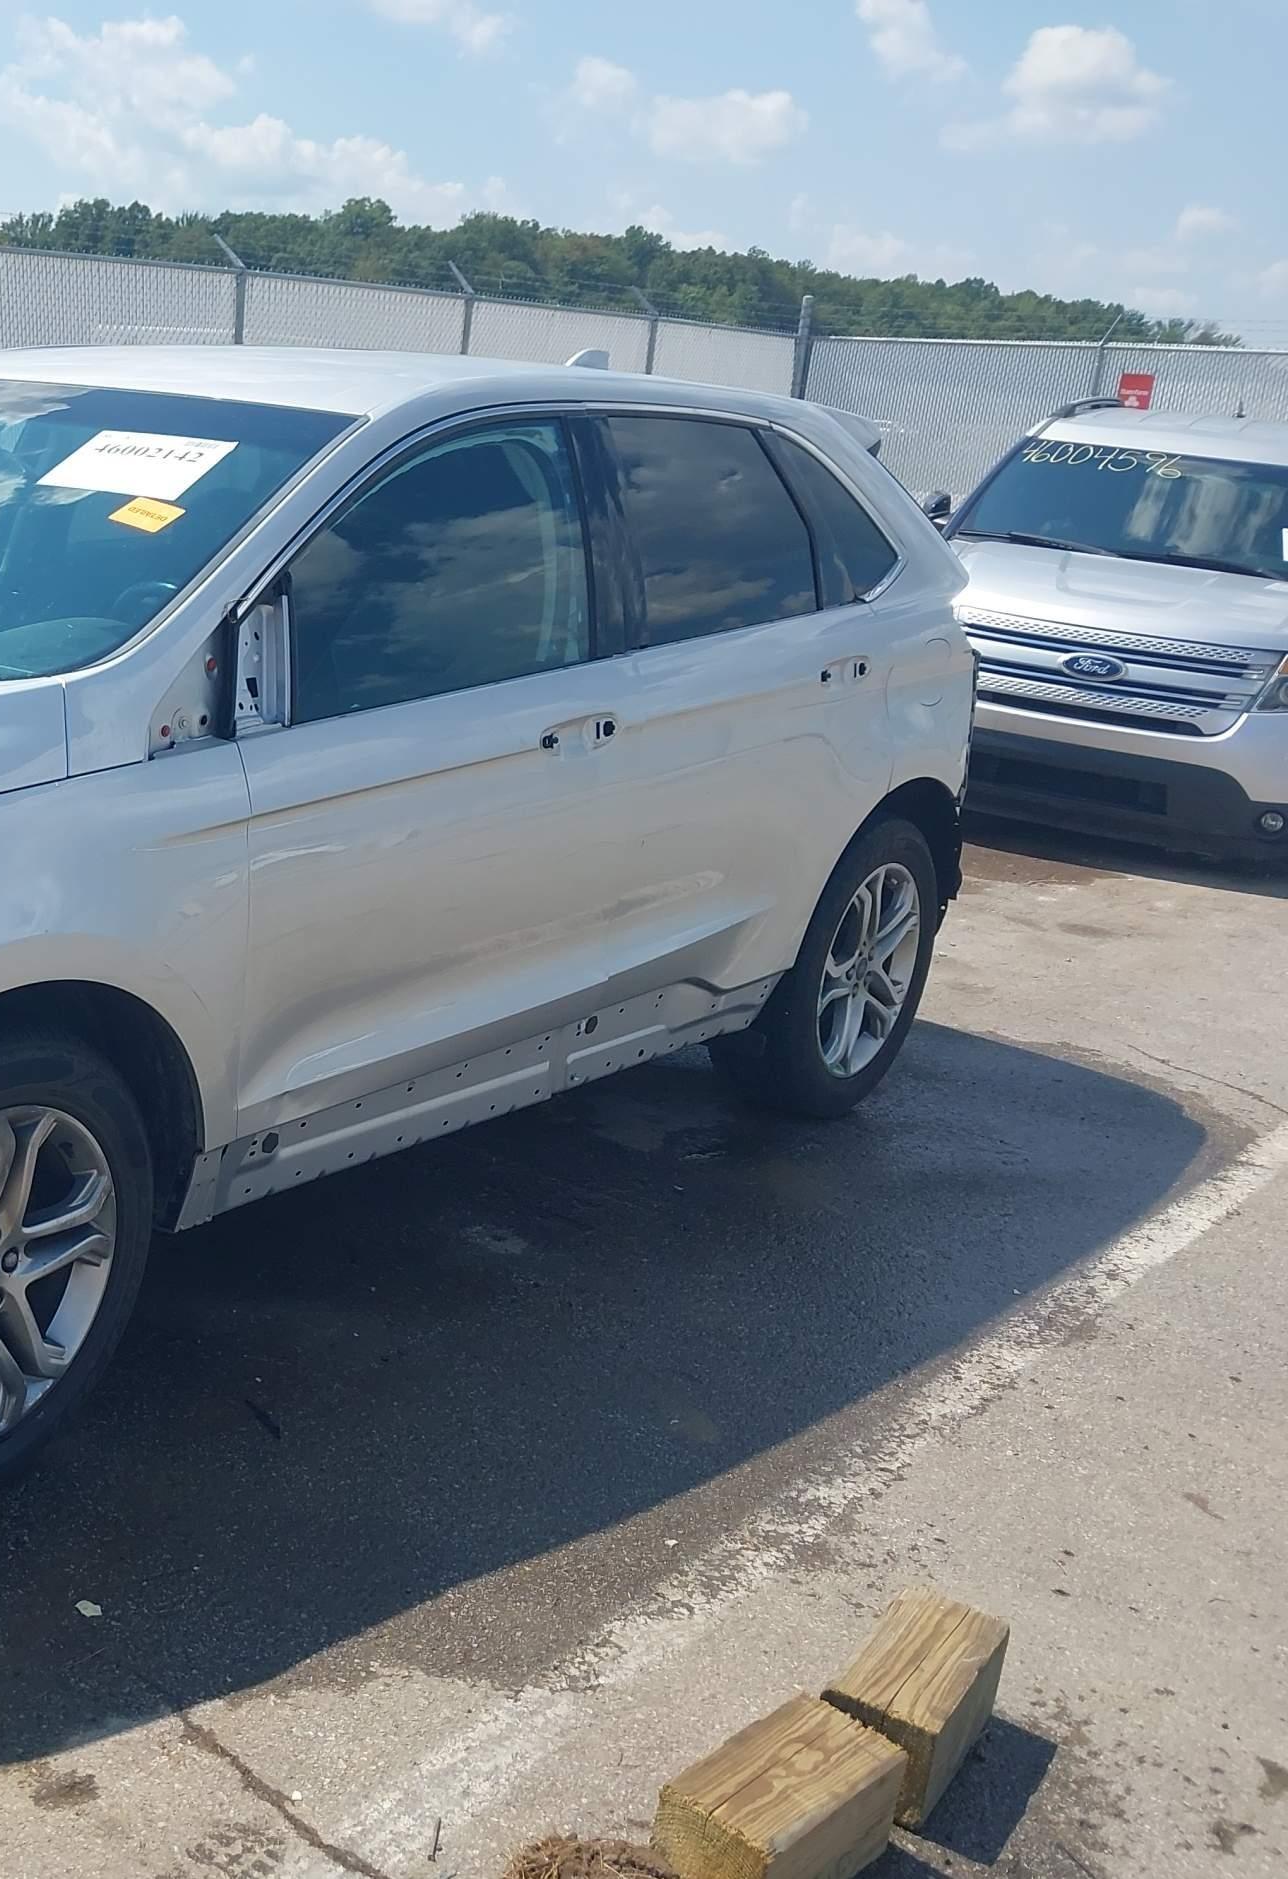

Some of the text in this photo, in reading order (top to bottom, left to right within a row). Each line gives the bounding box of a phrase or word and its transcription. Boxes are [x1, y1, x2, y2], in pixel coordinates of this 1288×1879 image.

[94, 443, 205, 463] 46002142
[1022, 440, 1182, 479] 46004596
[1073, 657, 1111, 675] Ford
